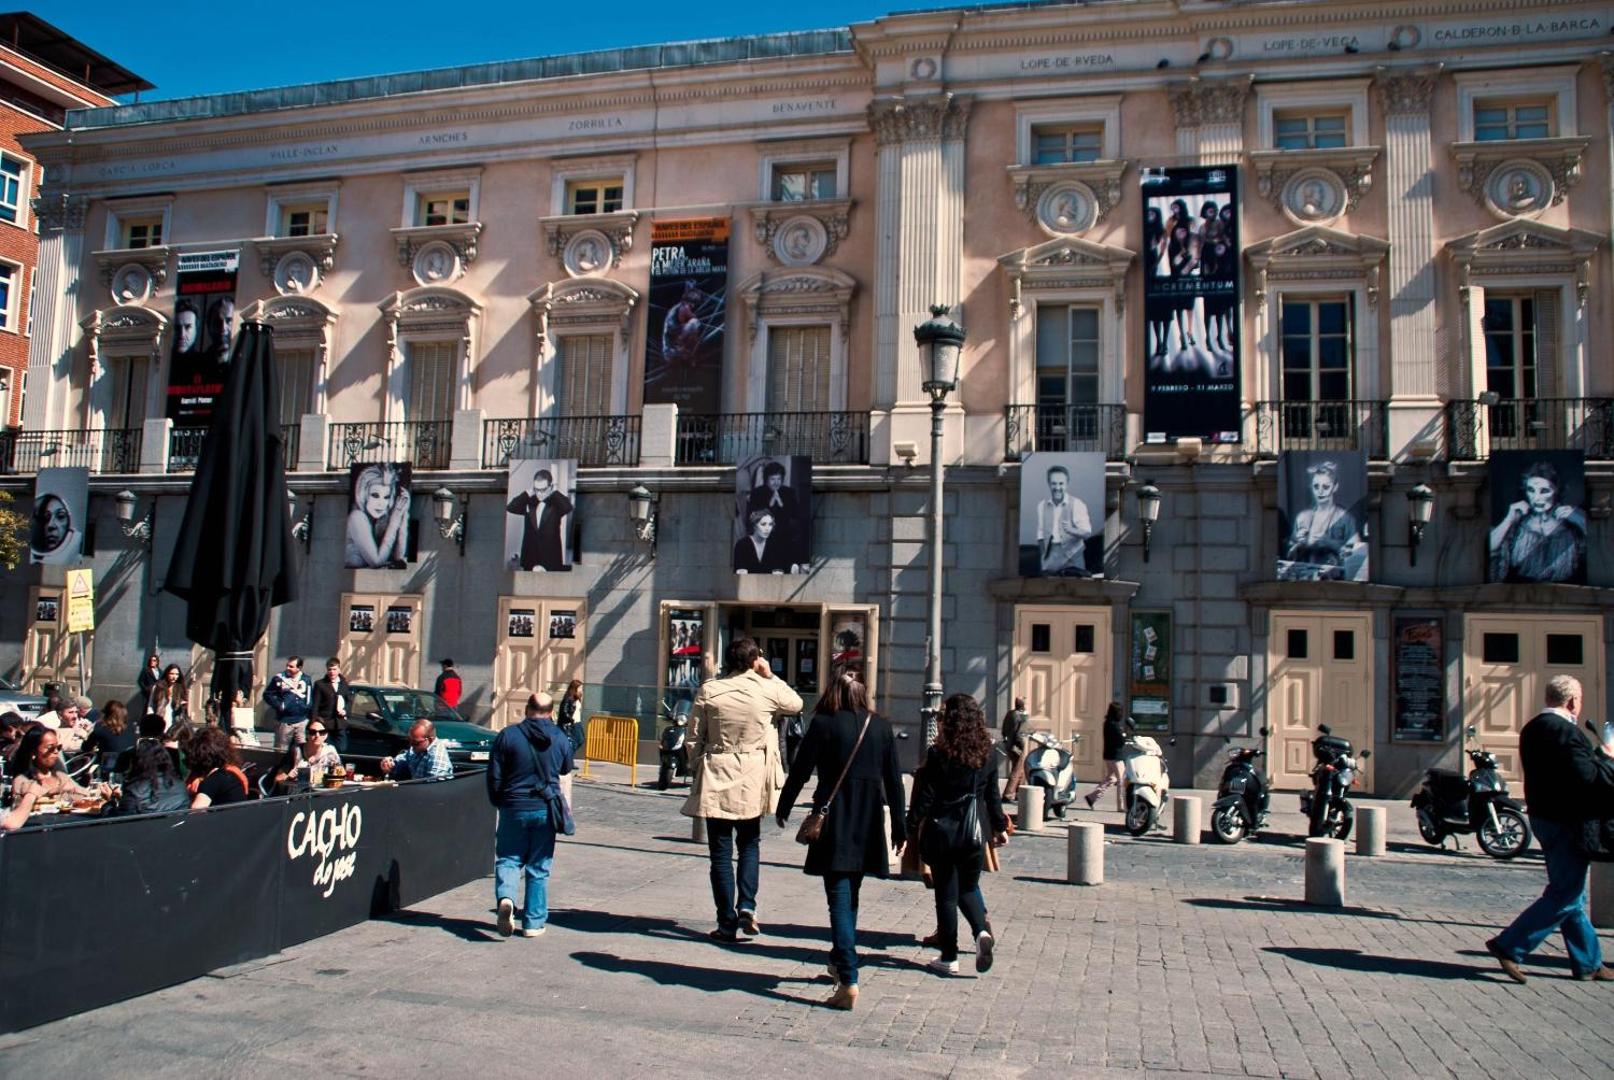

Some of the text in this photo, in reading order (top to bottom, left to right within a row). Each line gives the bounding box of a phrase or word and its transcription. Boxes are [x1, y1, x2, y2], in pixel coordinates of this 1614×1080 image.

[1551, 18, 1600, 33] BARCA
[772, 100, 838, 114] BENAVENTE
[567, 117, 623, 131] ZORRILLA
[418, 131, 469, 146] ARNICHES
[1150, 280, 1234, 291] NCREMENTUM
[288, 802, 362, 860] CACHO
